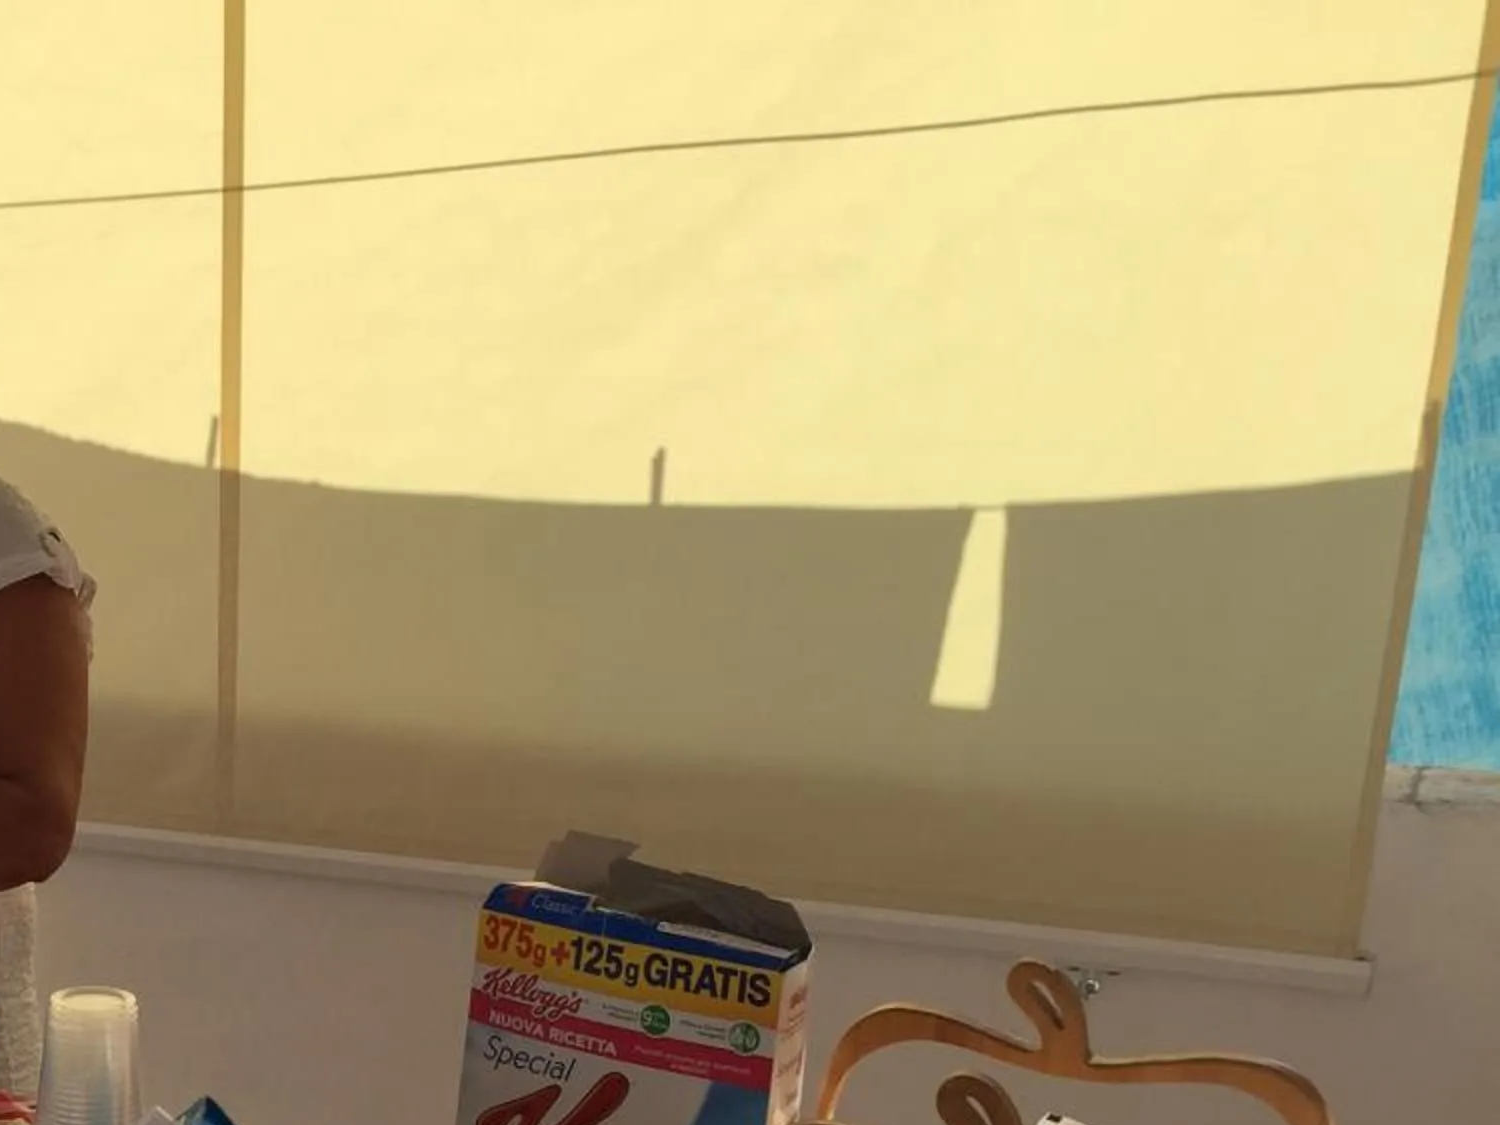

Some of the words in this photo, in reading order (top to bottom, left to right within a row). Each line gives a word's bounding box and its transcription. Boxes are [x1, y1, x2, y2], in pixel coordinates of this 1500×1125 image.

[482, 967, 583, 1017] Kellogg's
[643, 953, 772, 1008] GRATIS
[488, 1009, 546, 1039] NUOVA
[549, 1027, 618, 1057] RICETTA
[483, 1035, 577, 1082] Special
